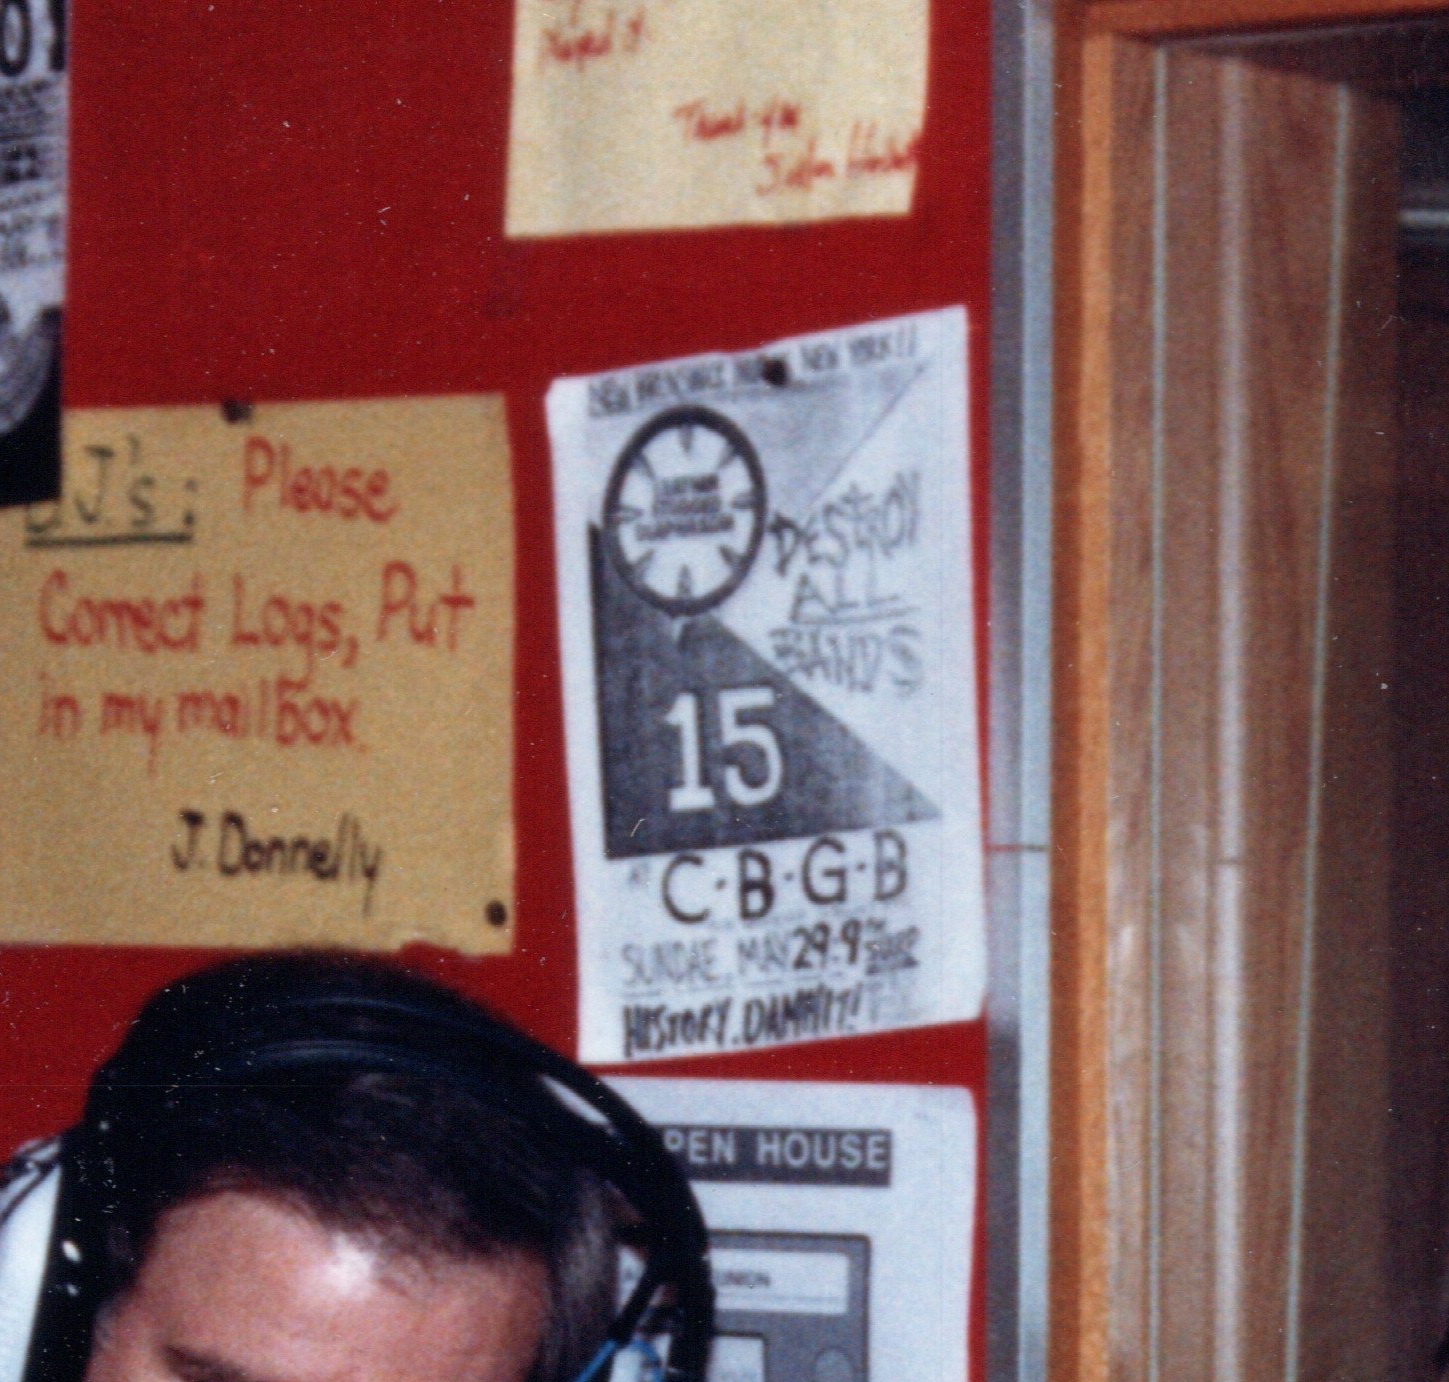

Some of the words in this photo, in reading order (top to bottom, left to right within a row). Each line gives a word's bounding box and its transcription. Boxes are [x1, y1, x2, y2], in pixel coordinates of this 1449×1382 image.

[242, 436, 397, 523] Please
[377, 559, 475, 652] Put
[789, 569, 901, 624] ALL
[663, 684, 783, 814] 15
[757, 1130, 890, 1170] HOUSE
